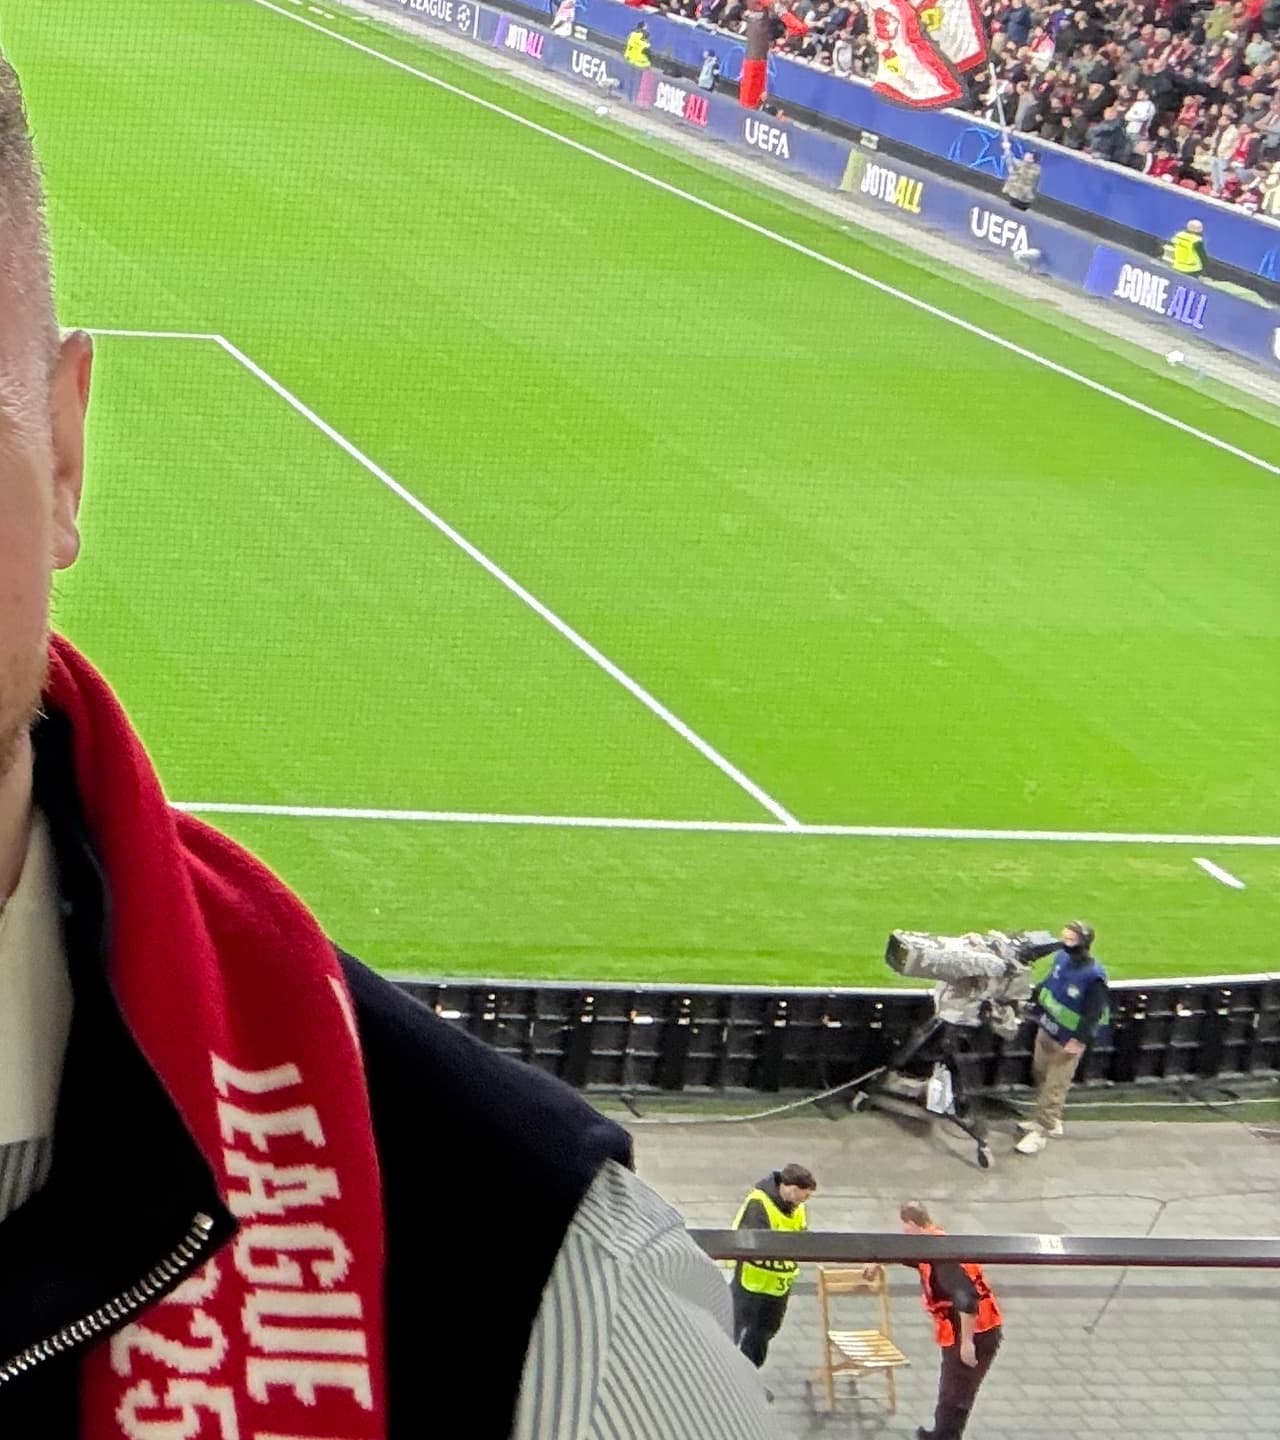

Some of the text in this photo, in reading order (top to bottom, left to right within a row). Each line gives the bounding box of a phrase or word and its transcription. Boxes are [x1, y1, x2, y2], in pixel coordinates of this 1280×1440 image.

[572, 50, 608, 82] UEFA
[744, 117, 790, 160] UEFA
[970, 206, 1030, 252] UEFA
[1167, 286, 1209, 330] ALL
[208, 1050, 374, 1412] LEAGUE
